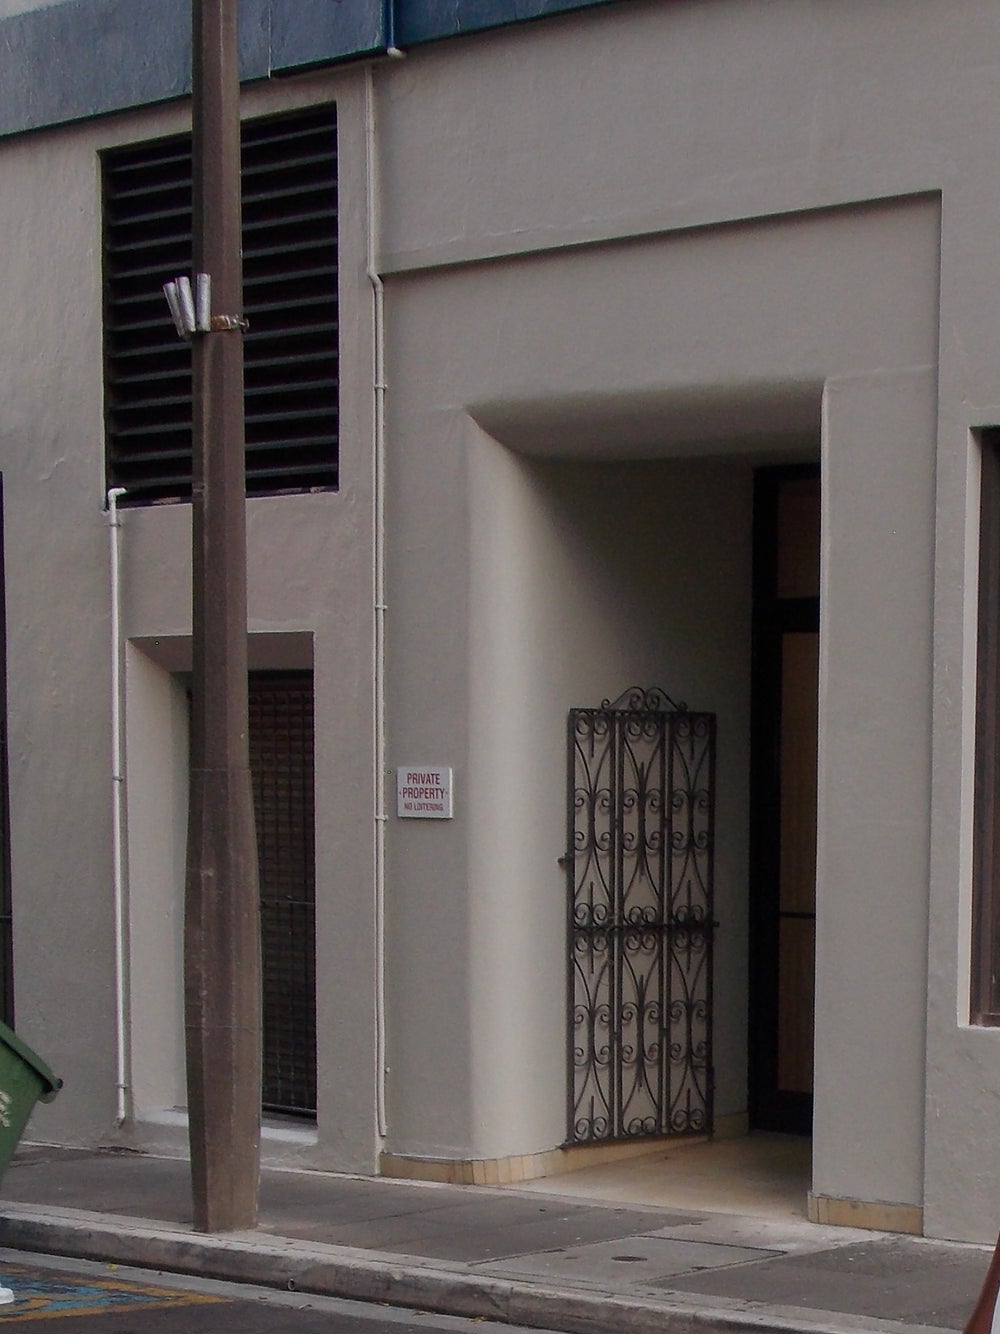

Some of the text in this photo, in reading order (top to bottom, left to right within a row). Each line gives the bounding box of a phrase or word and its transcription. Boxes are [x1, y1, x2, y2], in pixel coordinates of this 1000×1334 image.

[407, 773, 440, 785] PRIVATE
[402, 787, 445, 799] PROPERTY
[404, 802, 413, 811] NO
